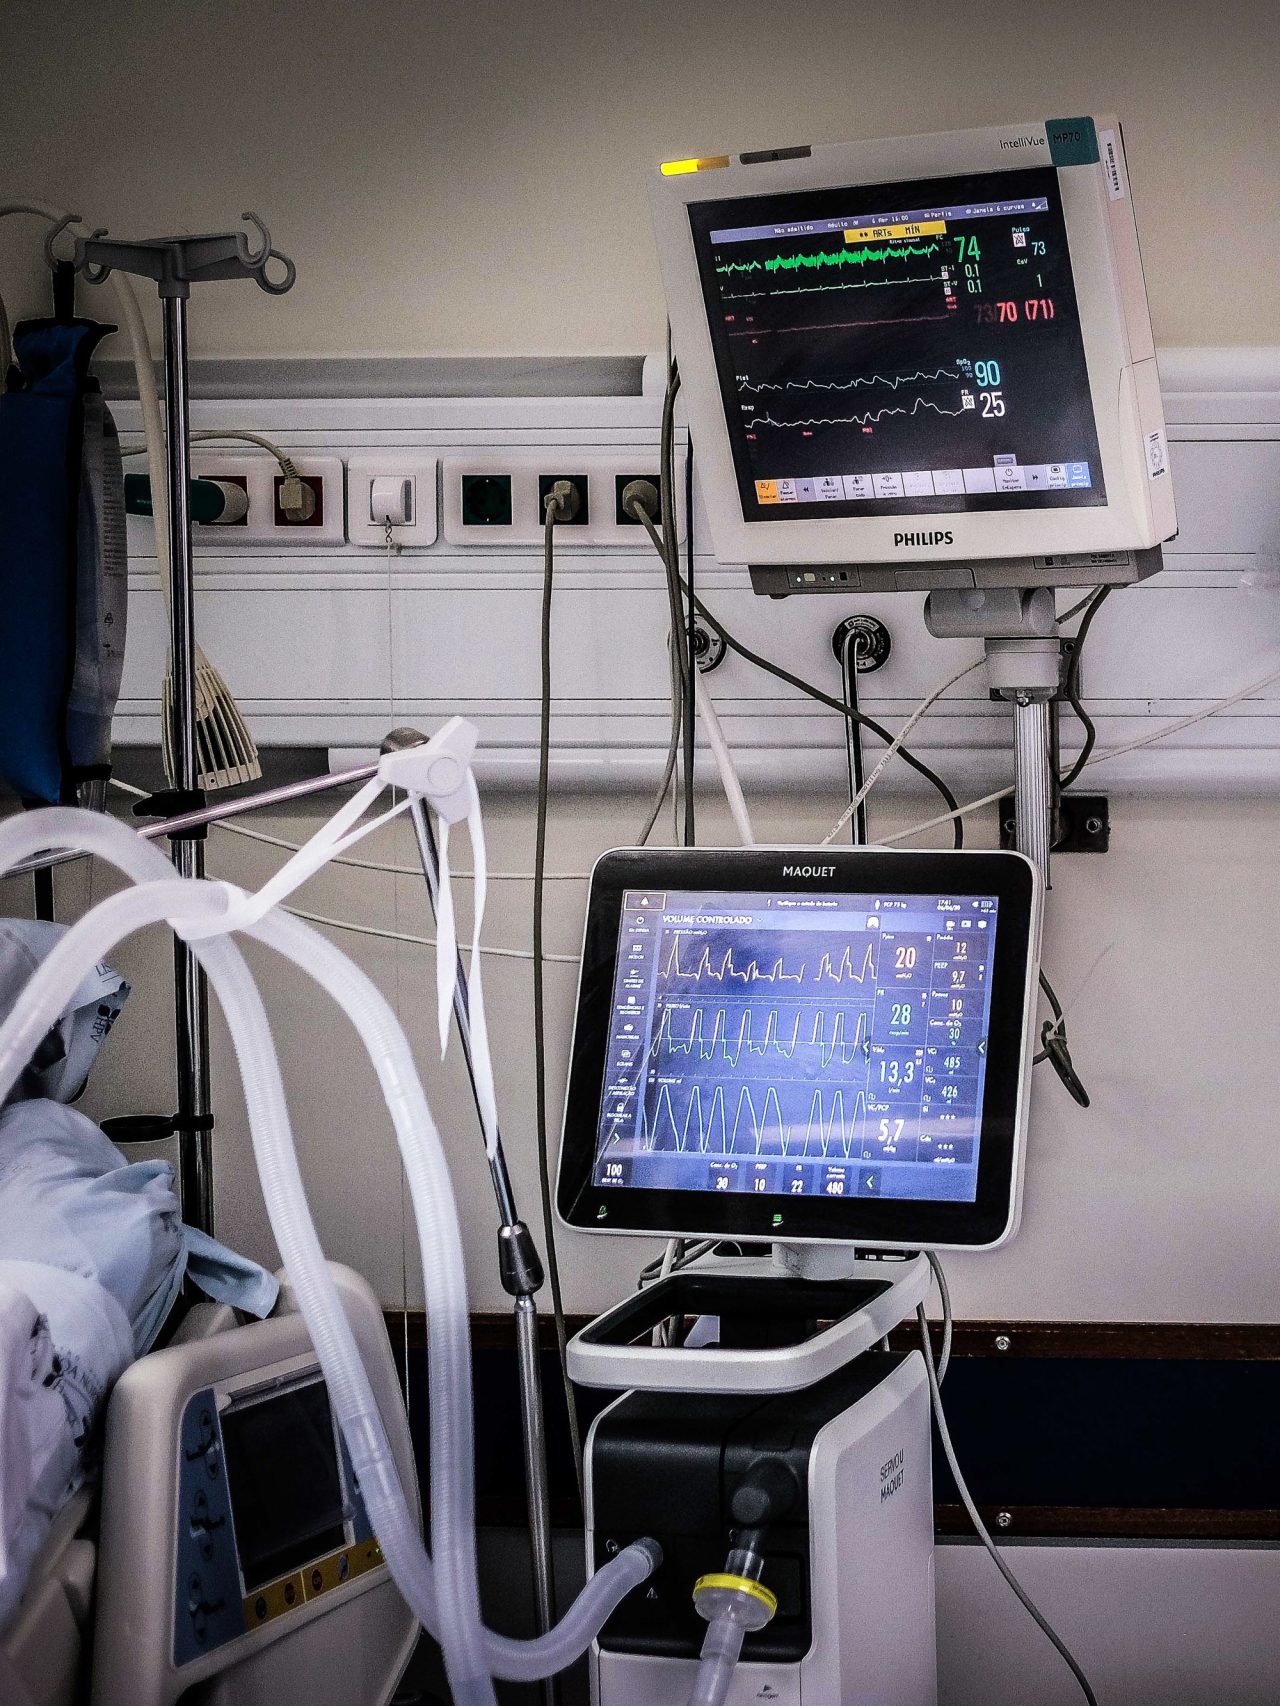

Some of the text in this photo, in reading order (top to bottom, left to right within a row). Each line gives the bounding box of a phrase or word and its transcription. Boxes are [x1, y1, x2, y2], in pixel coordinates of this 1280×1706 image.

[999, 131, 1081, 150] IntelliVue MP70
[872, 224, 921, 238] ARTs MÍN
[953, 235, 981, 263] 74
[1031, 241, 1046, 256] 73
[964, 263, 980, 278] 0.1
[967, 279, 982, 294] 0.1
[1036, 273, 1043, 288] 1
[1024, 298, 1055, 321] (71)
[974, 360, 1001, 387] 90
[979, 391, 1006, 418] 25
[893, 531, 954, 547] PHILIPS
[782, 865, 836, 878] MAQUET
[663, 915, 753, 925] VOLUME CONTROLADO
[956, 942, 968, 954] 12
[894, 946, 917, 969] 20
[951, 970, 966, 984] 9,7
[951, 998, 963, 1011] 10
[890, 1003, 912, 1025] 28
[948, 1027, 960, 1039] 30
[943, 1056, 961, 1069] 485
[879, 1060, 915, 1087] 13,3
[941, 1085, 958, 1098] 426
[877, 1118, 905, 1145] 5,7
[605, 1163, 623, 1176] 100
[716, 1176, 728, 1189] 30
[754, 1178, 766, 1191] 10
[790, 1180, 804, 1193] 22
[825, 1181, 844, 1194] 480
[880, 1468, 905, 1503] MAQUET
